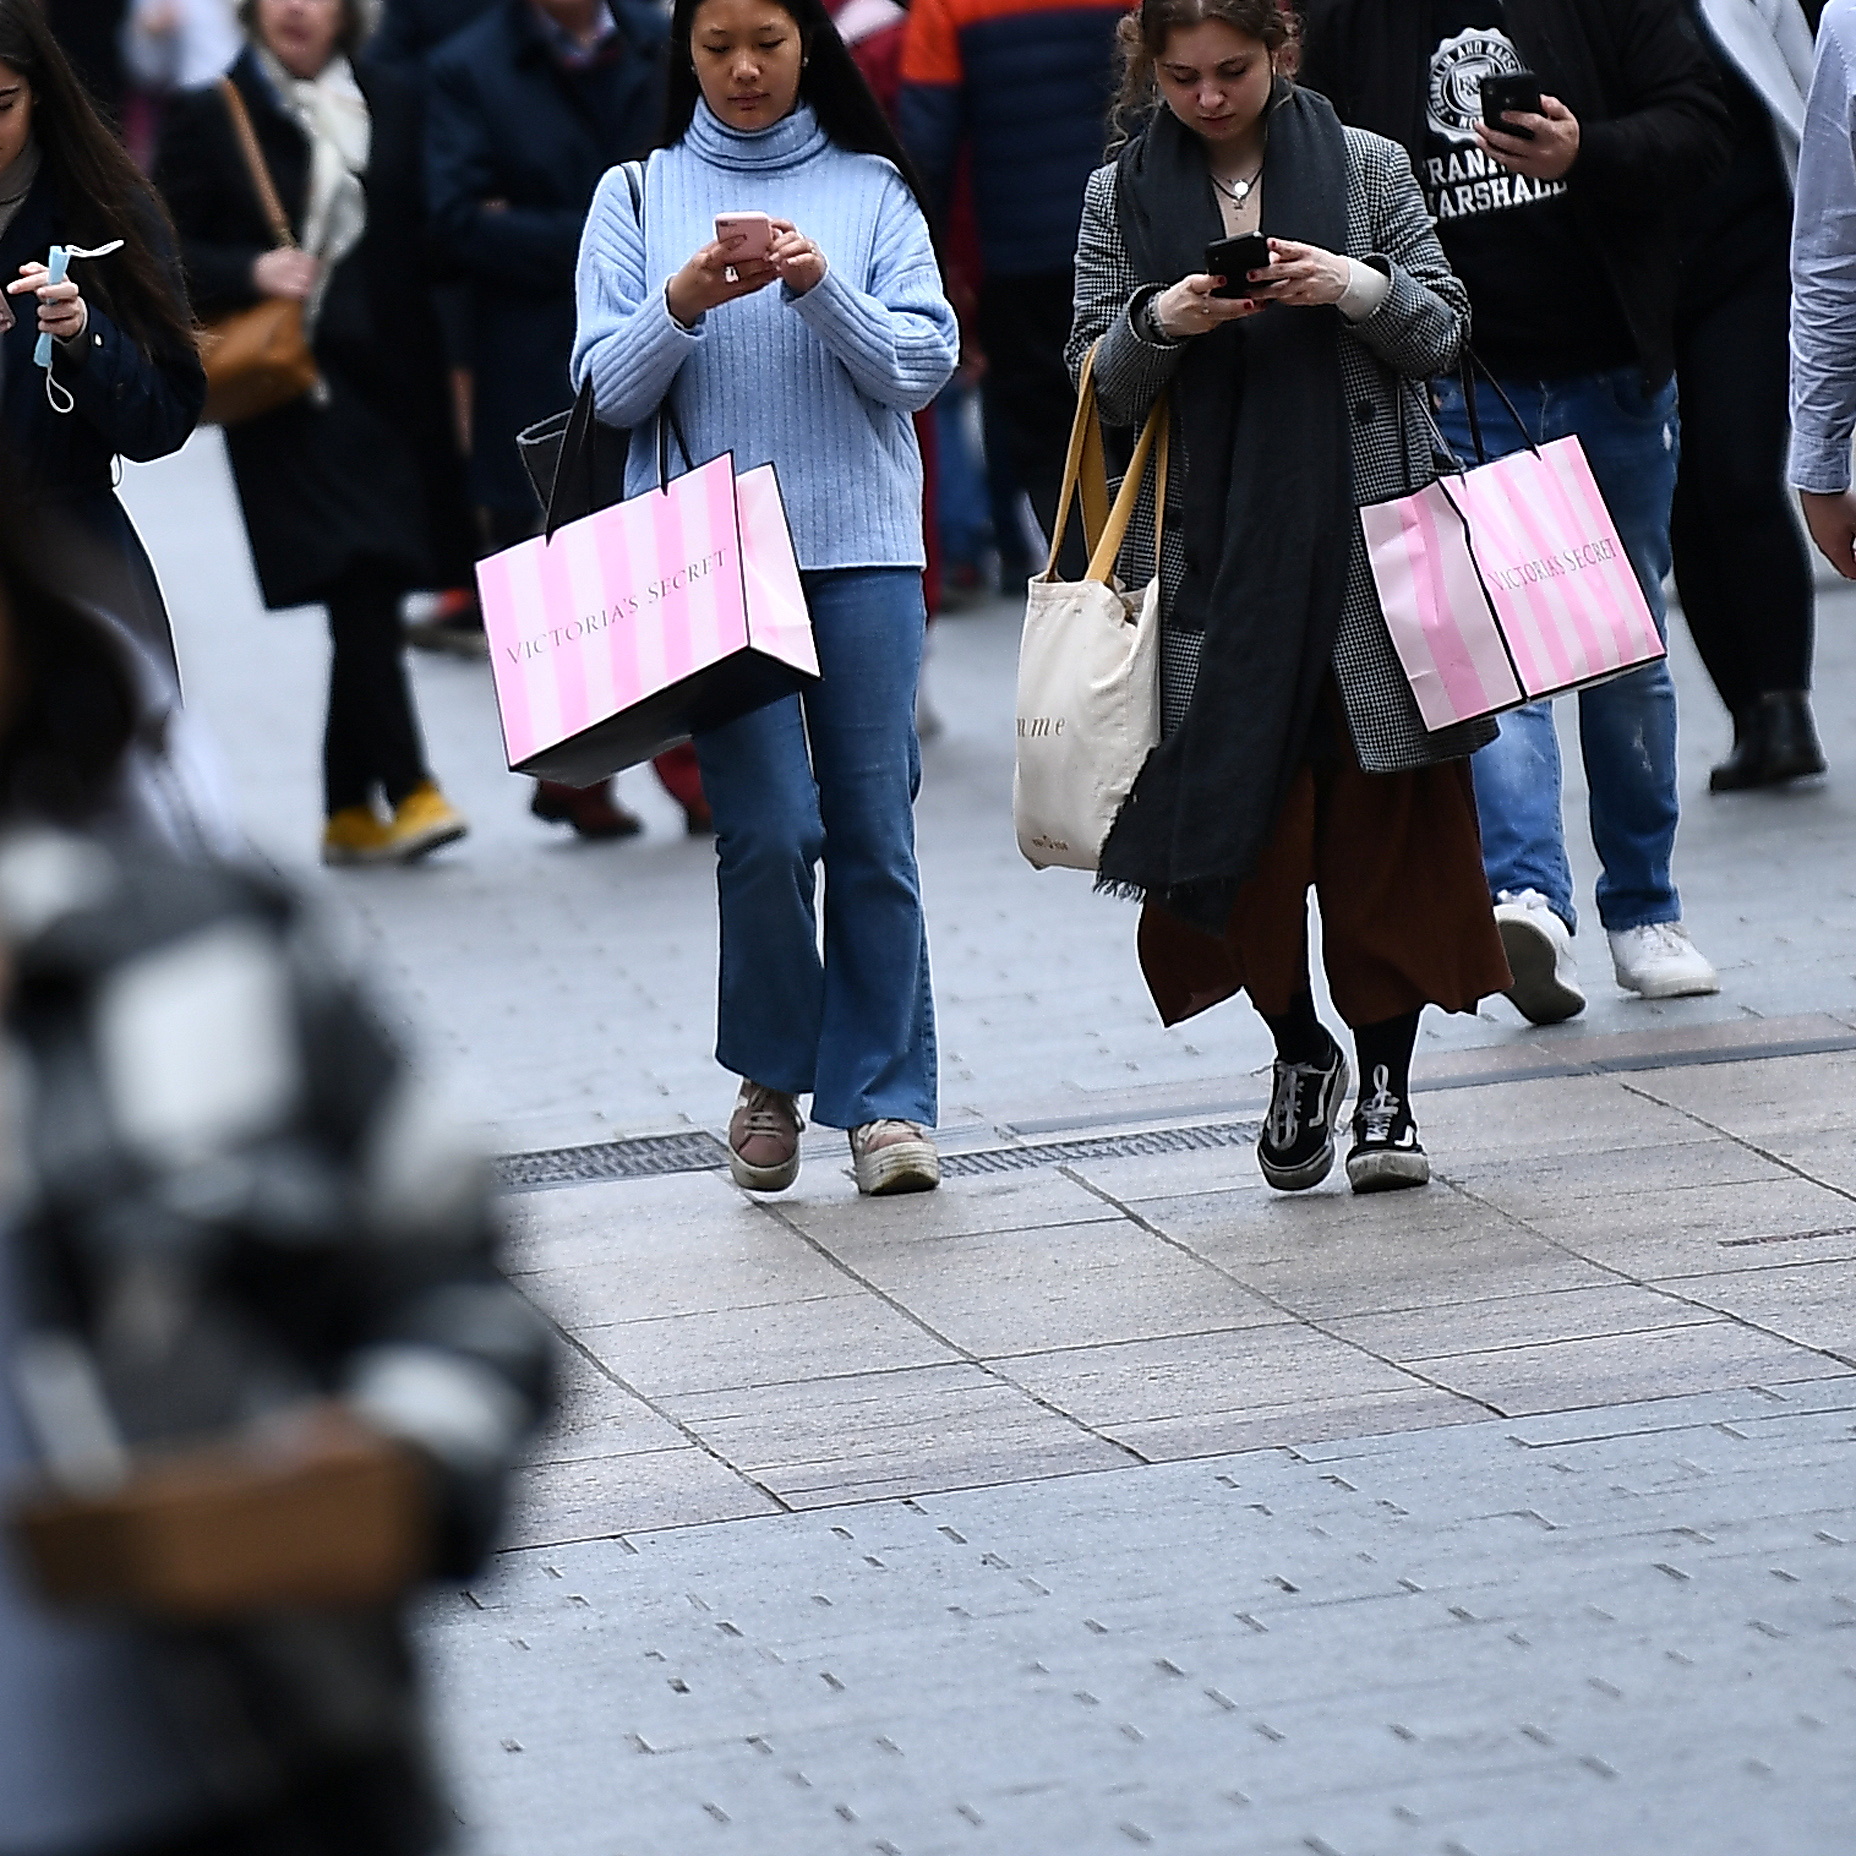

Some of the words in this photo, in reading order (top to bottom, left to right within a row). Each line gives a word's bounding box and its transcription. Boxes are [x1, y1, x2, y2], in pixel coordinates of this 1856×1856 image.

[1457, 40, 1483, 59] AND
[1487, 555, 1566, 591] VICTORIA'S
[1562, 537, 1617, 572] SECRET
[506, 595, 640, 664] VICTORIA'S
[647, 548, 727, 604] SECRET
